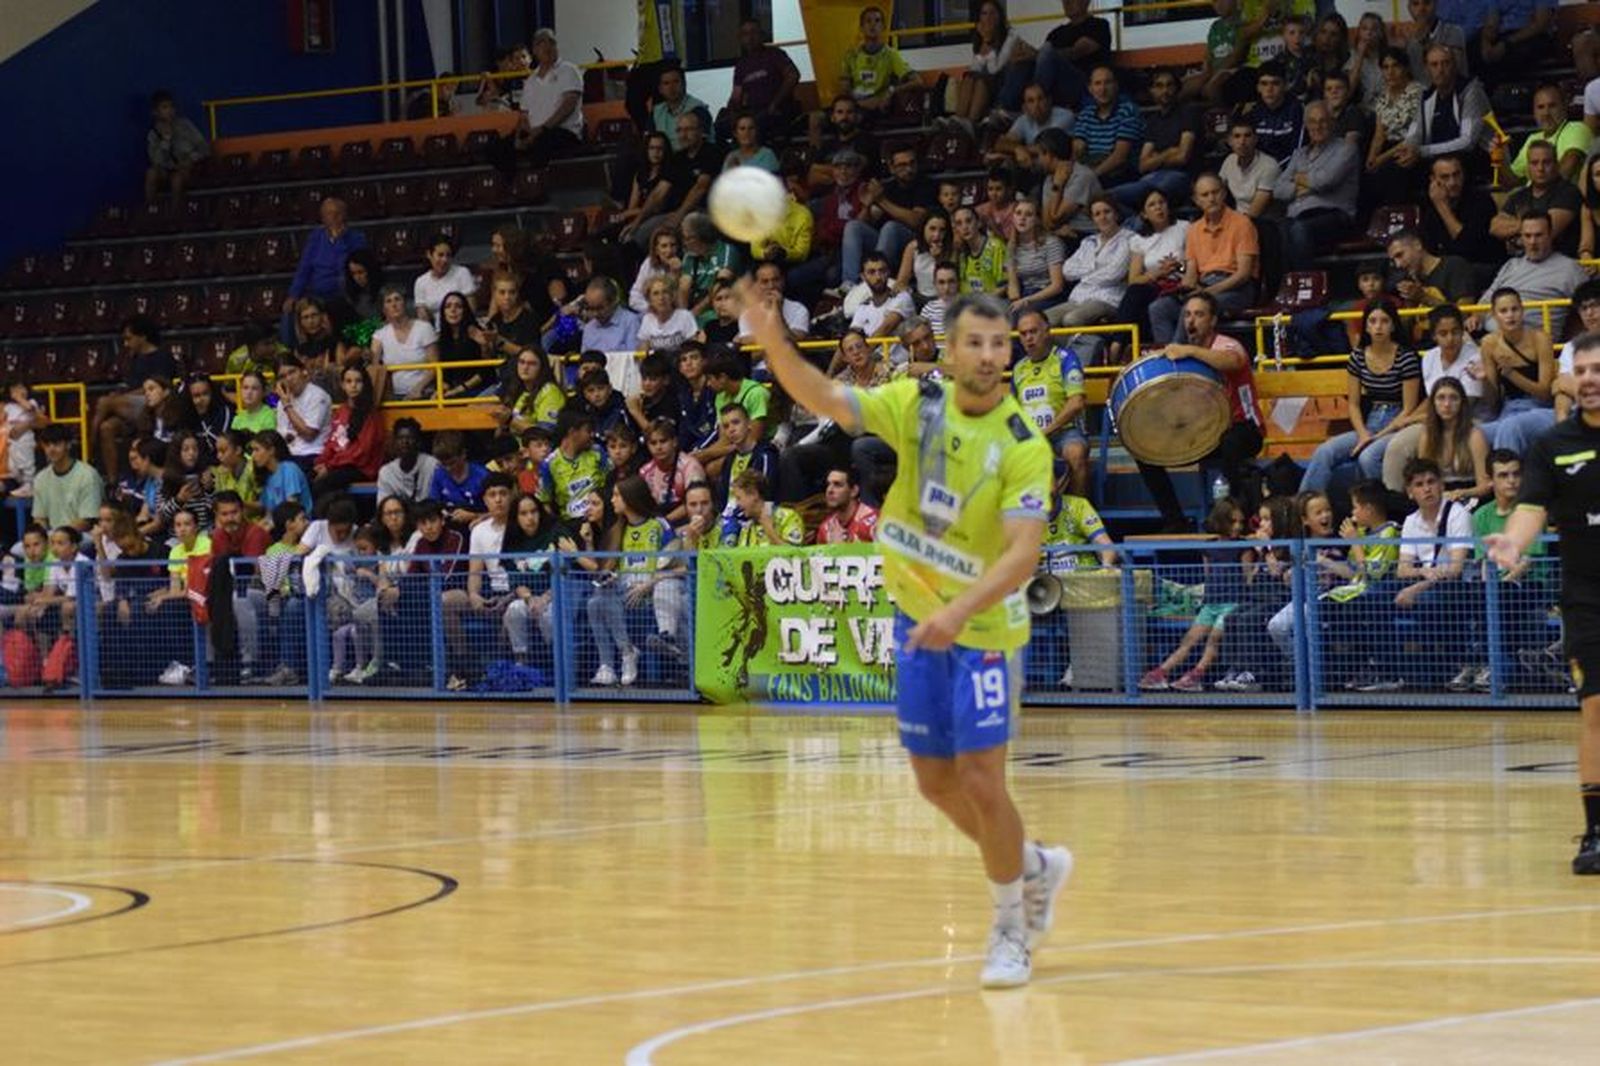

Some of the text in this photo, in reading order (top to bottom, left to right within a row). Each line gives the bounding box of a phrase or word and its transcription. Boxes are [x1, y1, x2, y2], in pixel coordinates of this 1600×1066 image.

[778, 616, 895, 668] DE VI
[767, 672, 897, 703] FANS BALONMA
[971, 667, 1005, 711] 19
